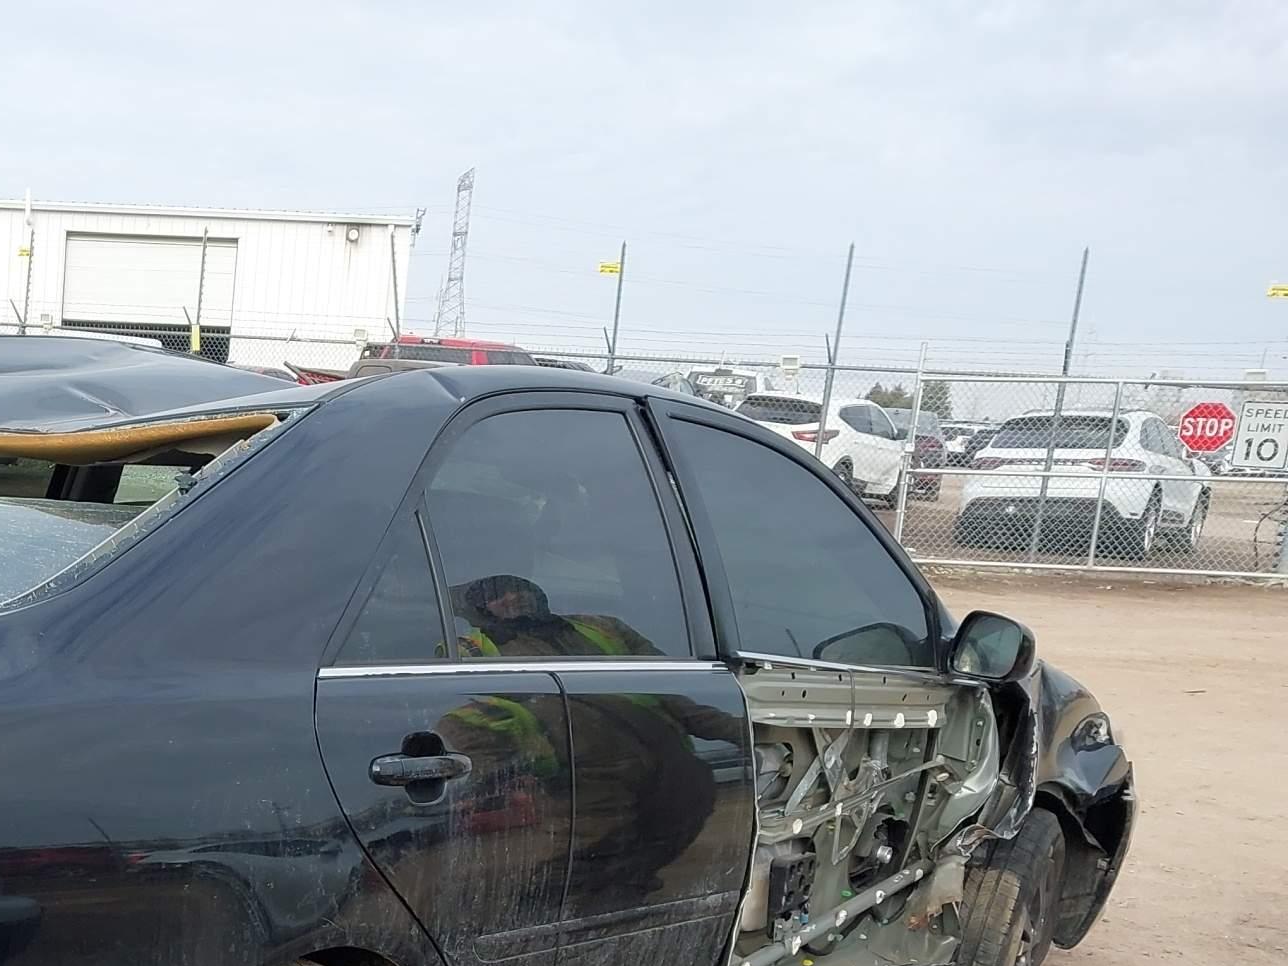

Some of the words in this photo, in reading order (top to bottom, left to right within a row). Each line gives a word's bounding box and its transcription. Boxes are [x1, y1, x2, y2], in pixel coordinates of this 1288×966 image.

[1181, 417, 1233, 437] STOP
[1247, 423, 1284, 433] LIMIT
[1244, 437, 1279, 461] 10
